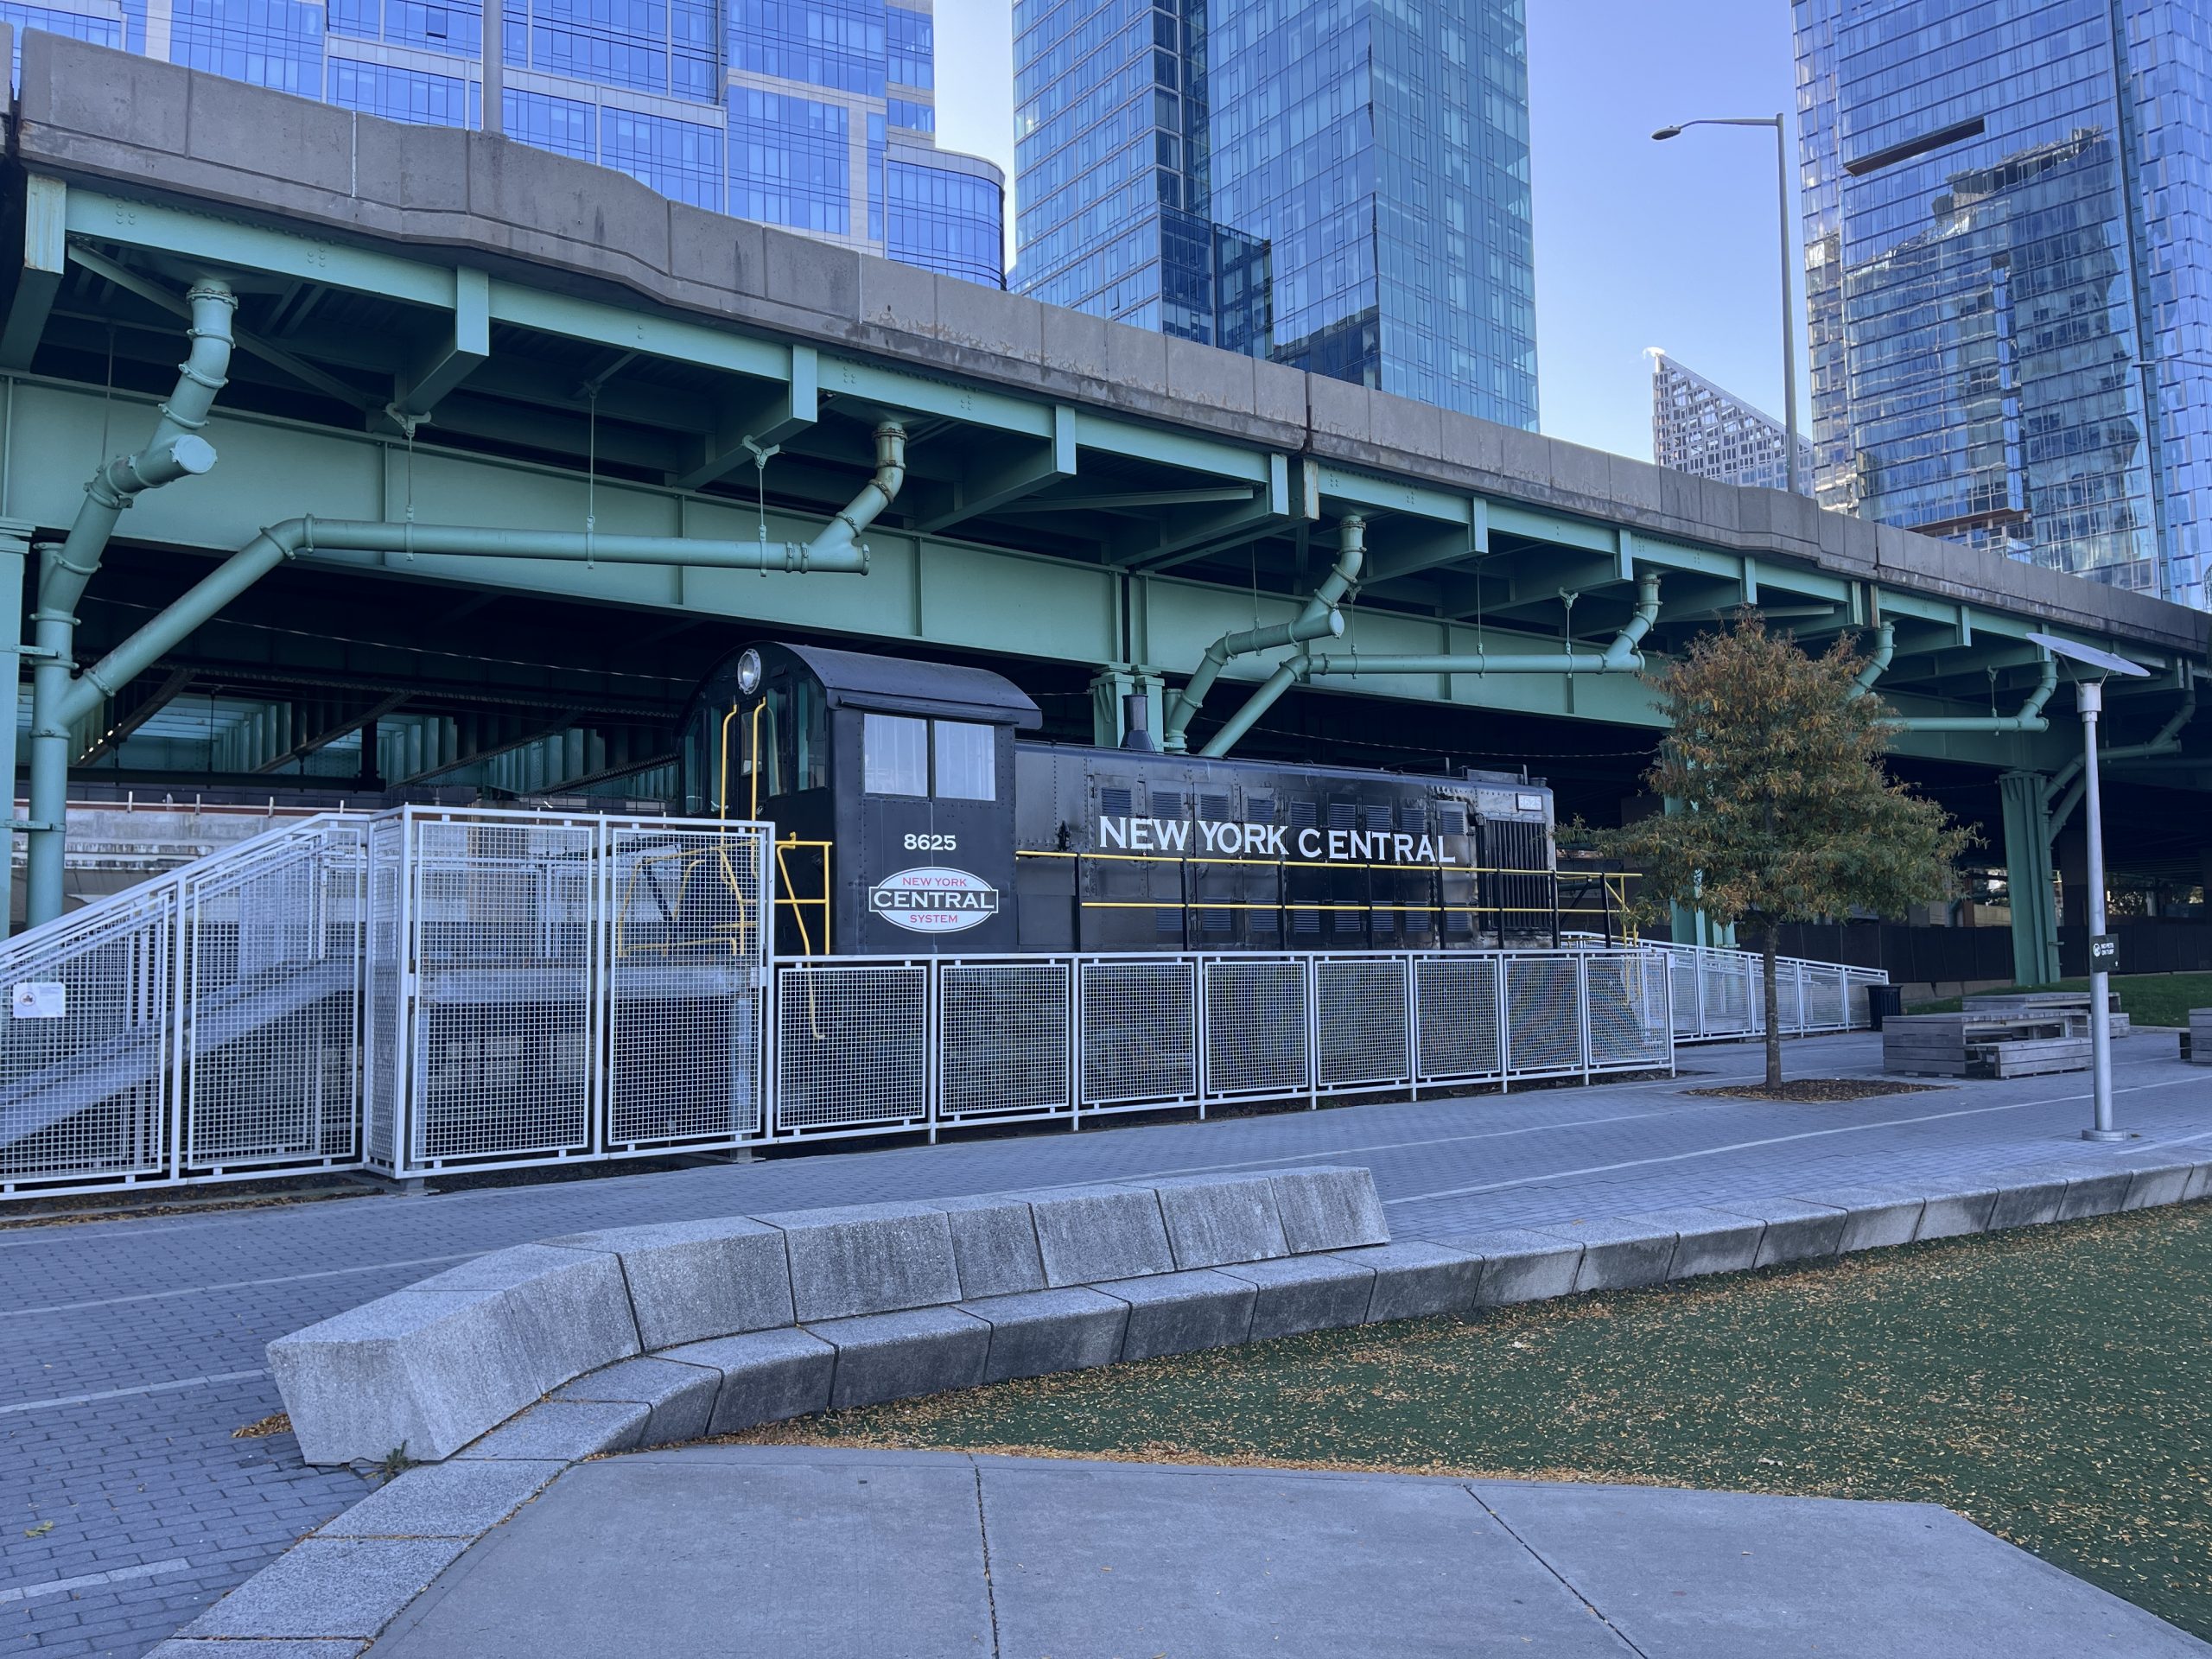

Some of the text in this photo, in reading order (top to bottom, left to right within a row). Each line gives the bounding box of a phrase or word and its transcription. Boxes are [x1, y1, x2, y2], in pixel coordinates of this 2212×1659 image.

[904, 834, 957, 850] 8625
[1099, 816, 1456, 863] NEW YORK CENTRAL
[902, 877, 967, 887] NEW YORK
[874, 891, 995, 908] CENTRAL
[910, 914, 958, 923] SYSTEM
